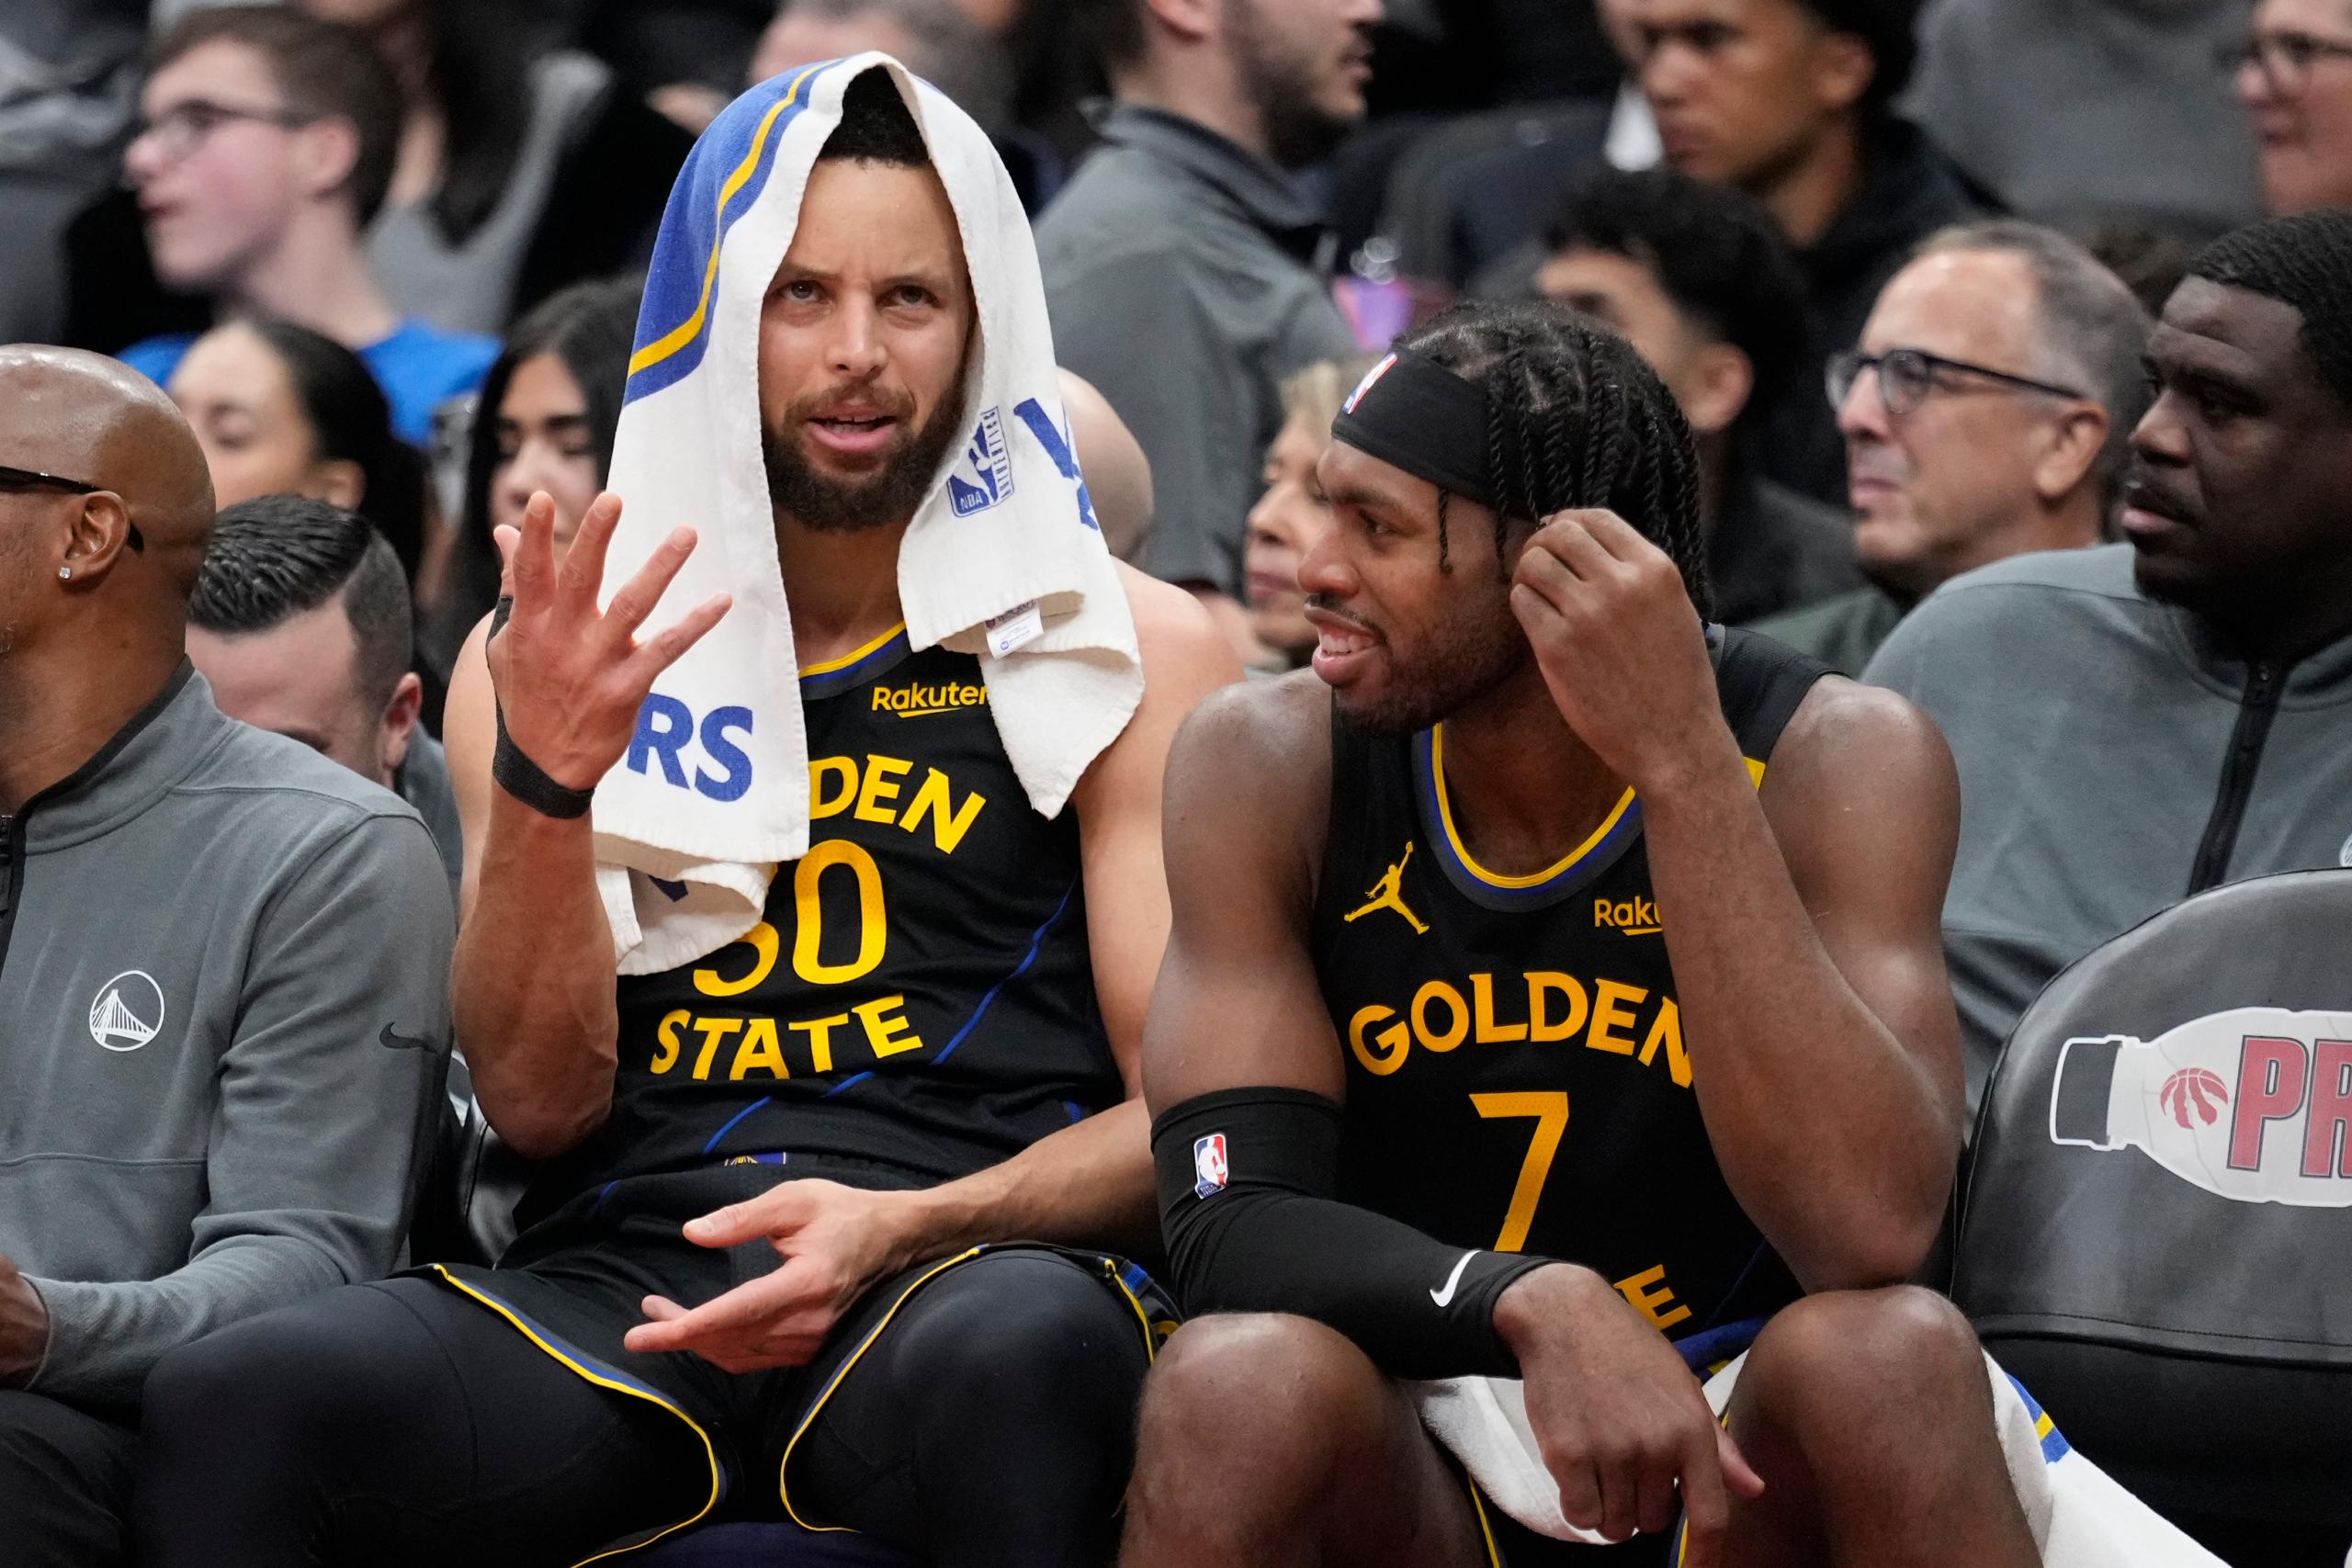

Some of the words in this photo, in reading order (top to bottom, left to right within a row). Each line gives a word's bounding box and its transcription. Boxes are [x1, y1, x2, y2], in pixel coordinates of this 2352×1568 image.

[959, 491, 984, 510] NBA
[650, 992, 923, 1081] STATE
[1349, 971, 1692, 1089] GOLDEN
[2226, 1035, 2352, 1179] PR
[1469, 1091, 1569, 1252] 7
